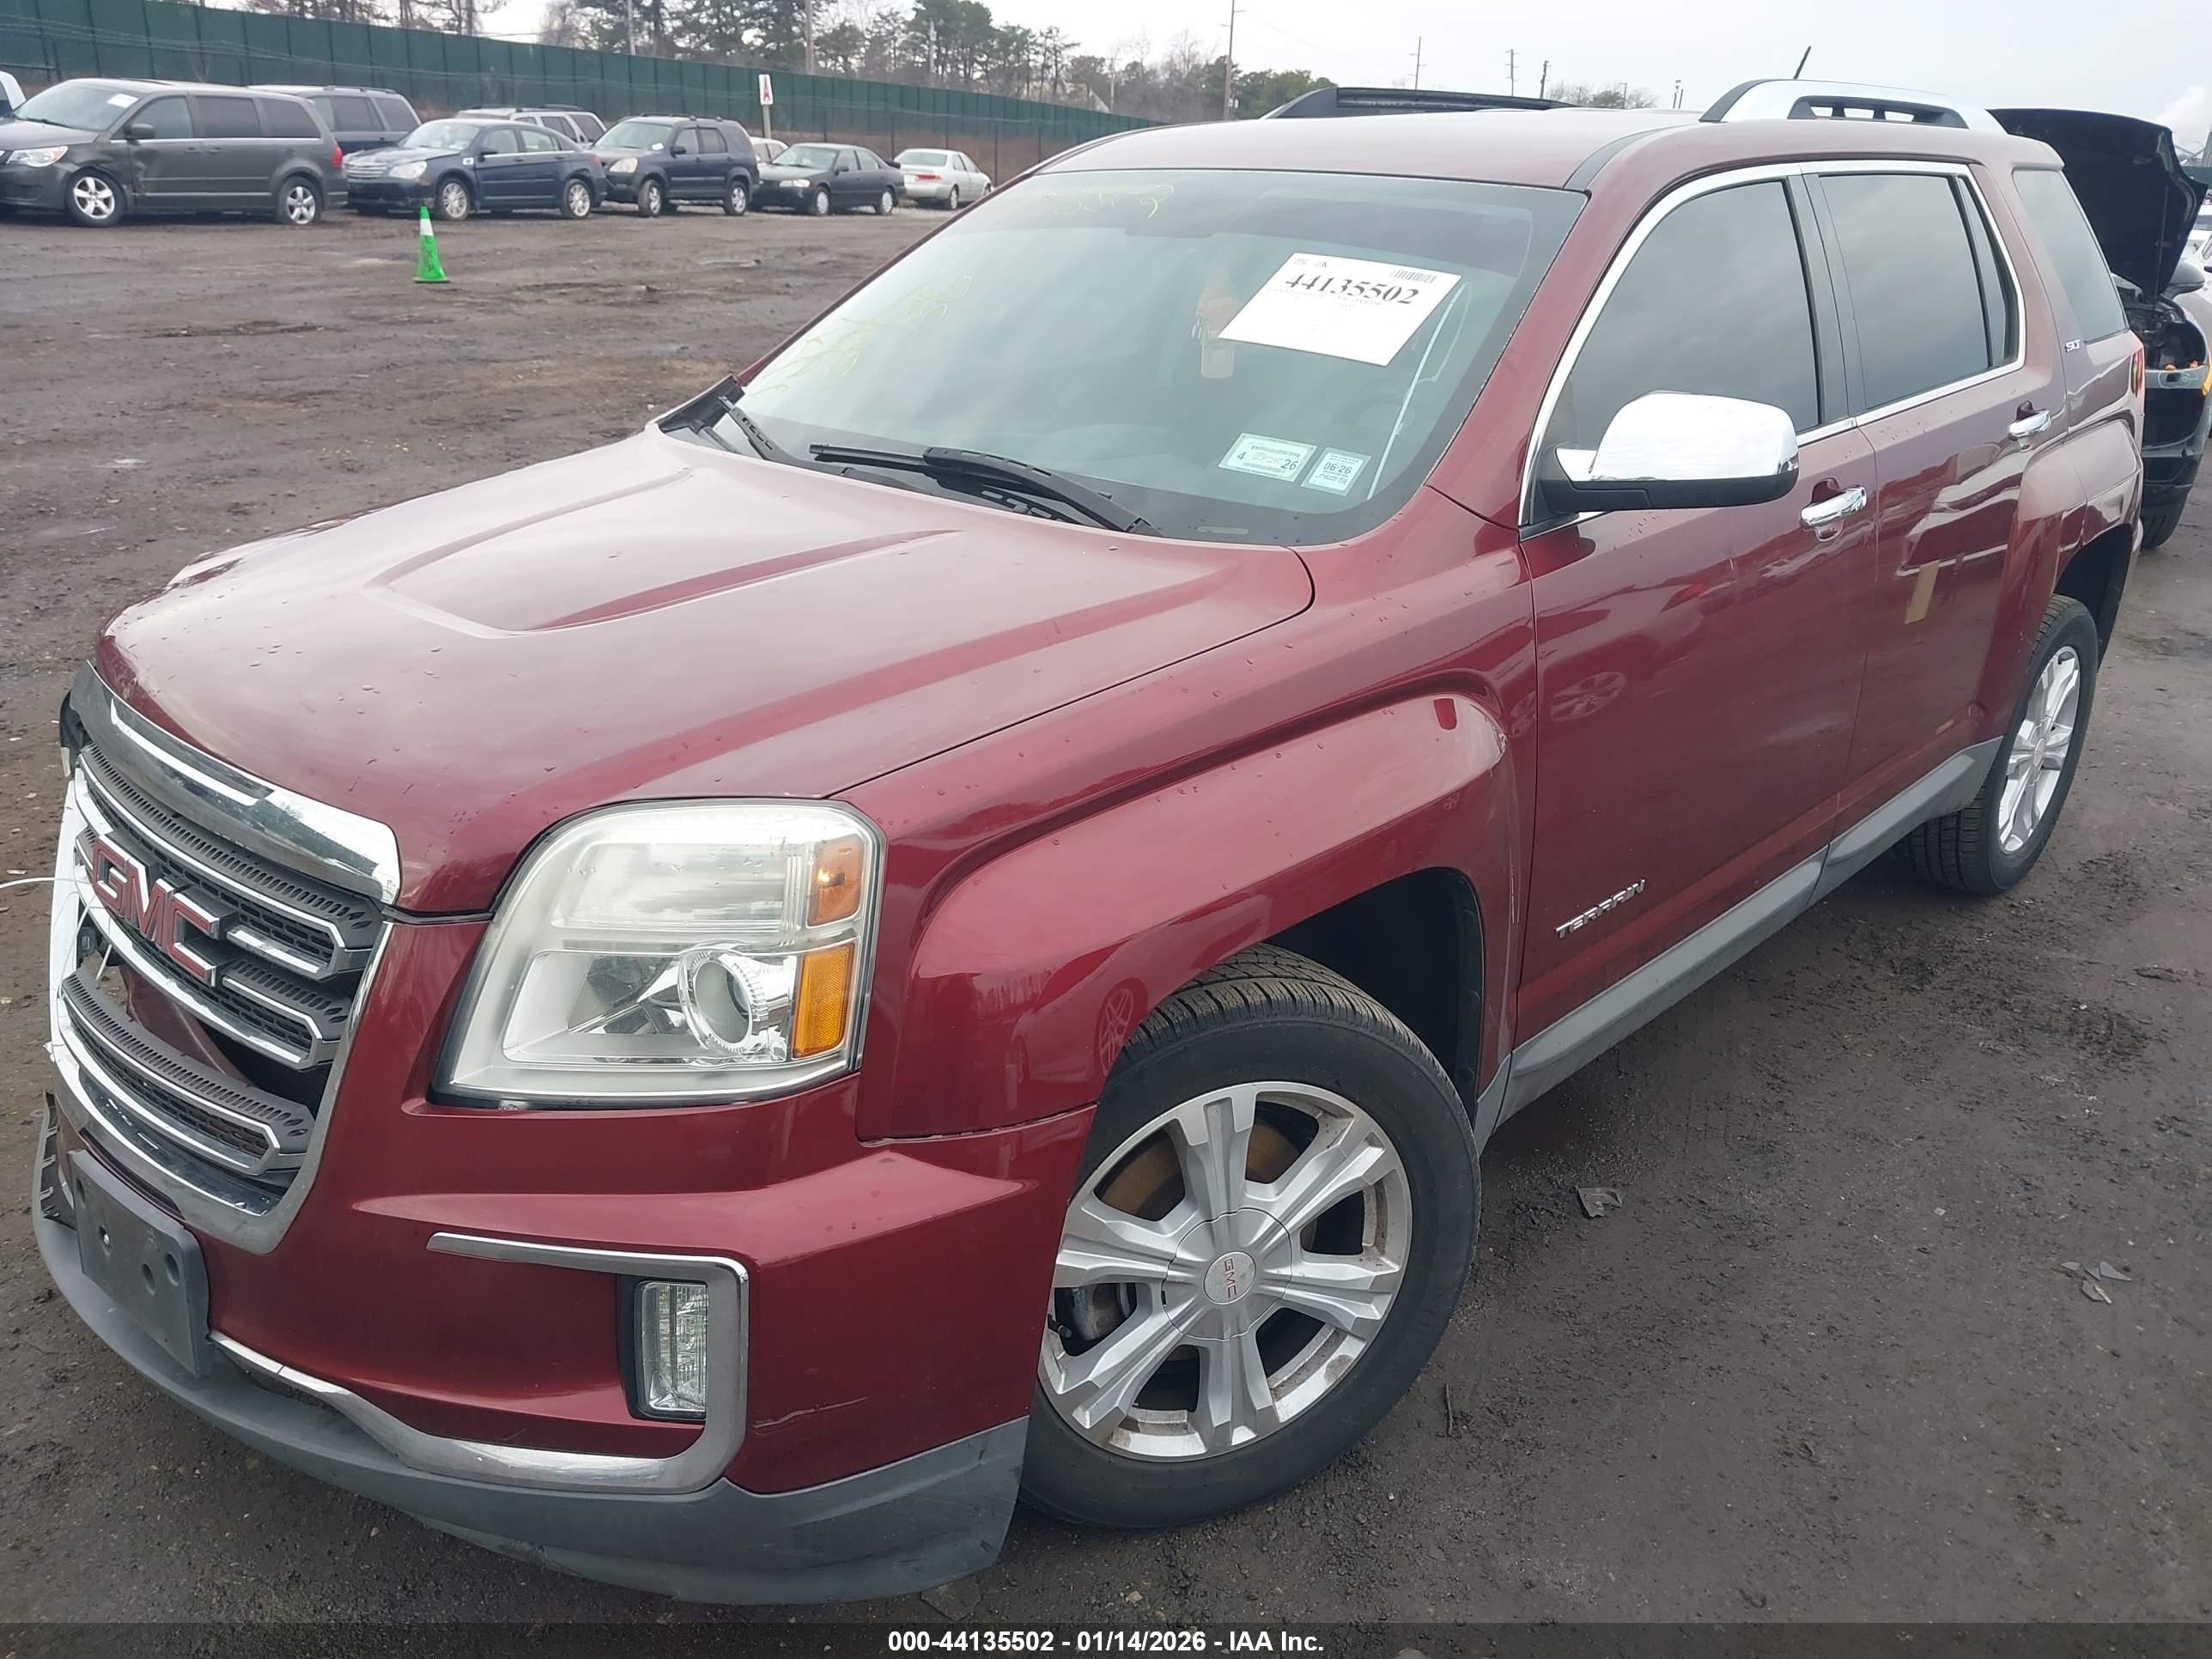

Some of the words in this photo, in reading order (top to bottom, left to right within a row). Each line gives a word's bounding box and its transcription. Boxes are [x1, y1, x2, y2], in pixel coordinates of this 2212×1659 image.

[1285, 273, 1419, 305] 44135502
[2064, 339, 2081, 352] SLT
[1280, 459, 1299, 471] 26
[92, 835, 219, 987] GMC
[1553, 878, 1645, 939] TERRAIN
[1224, 1258, 1237, 1299] GMC
